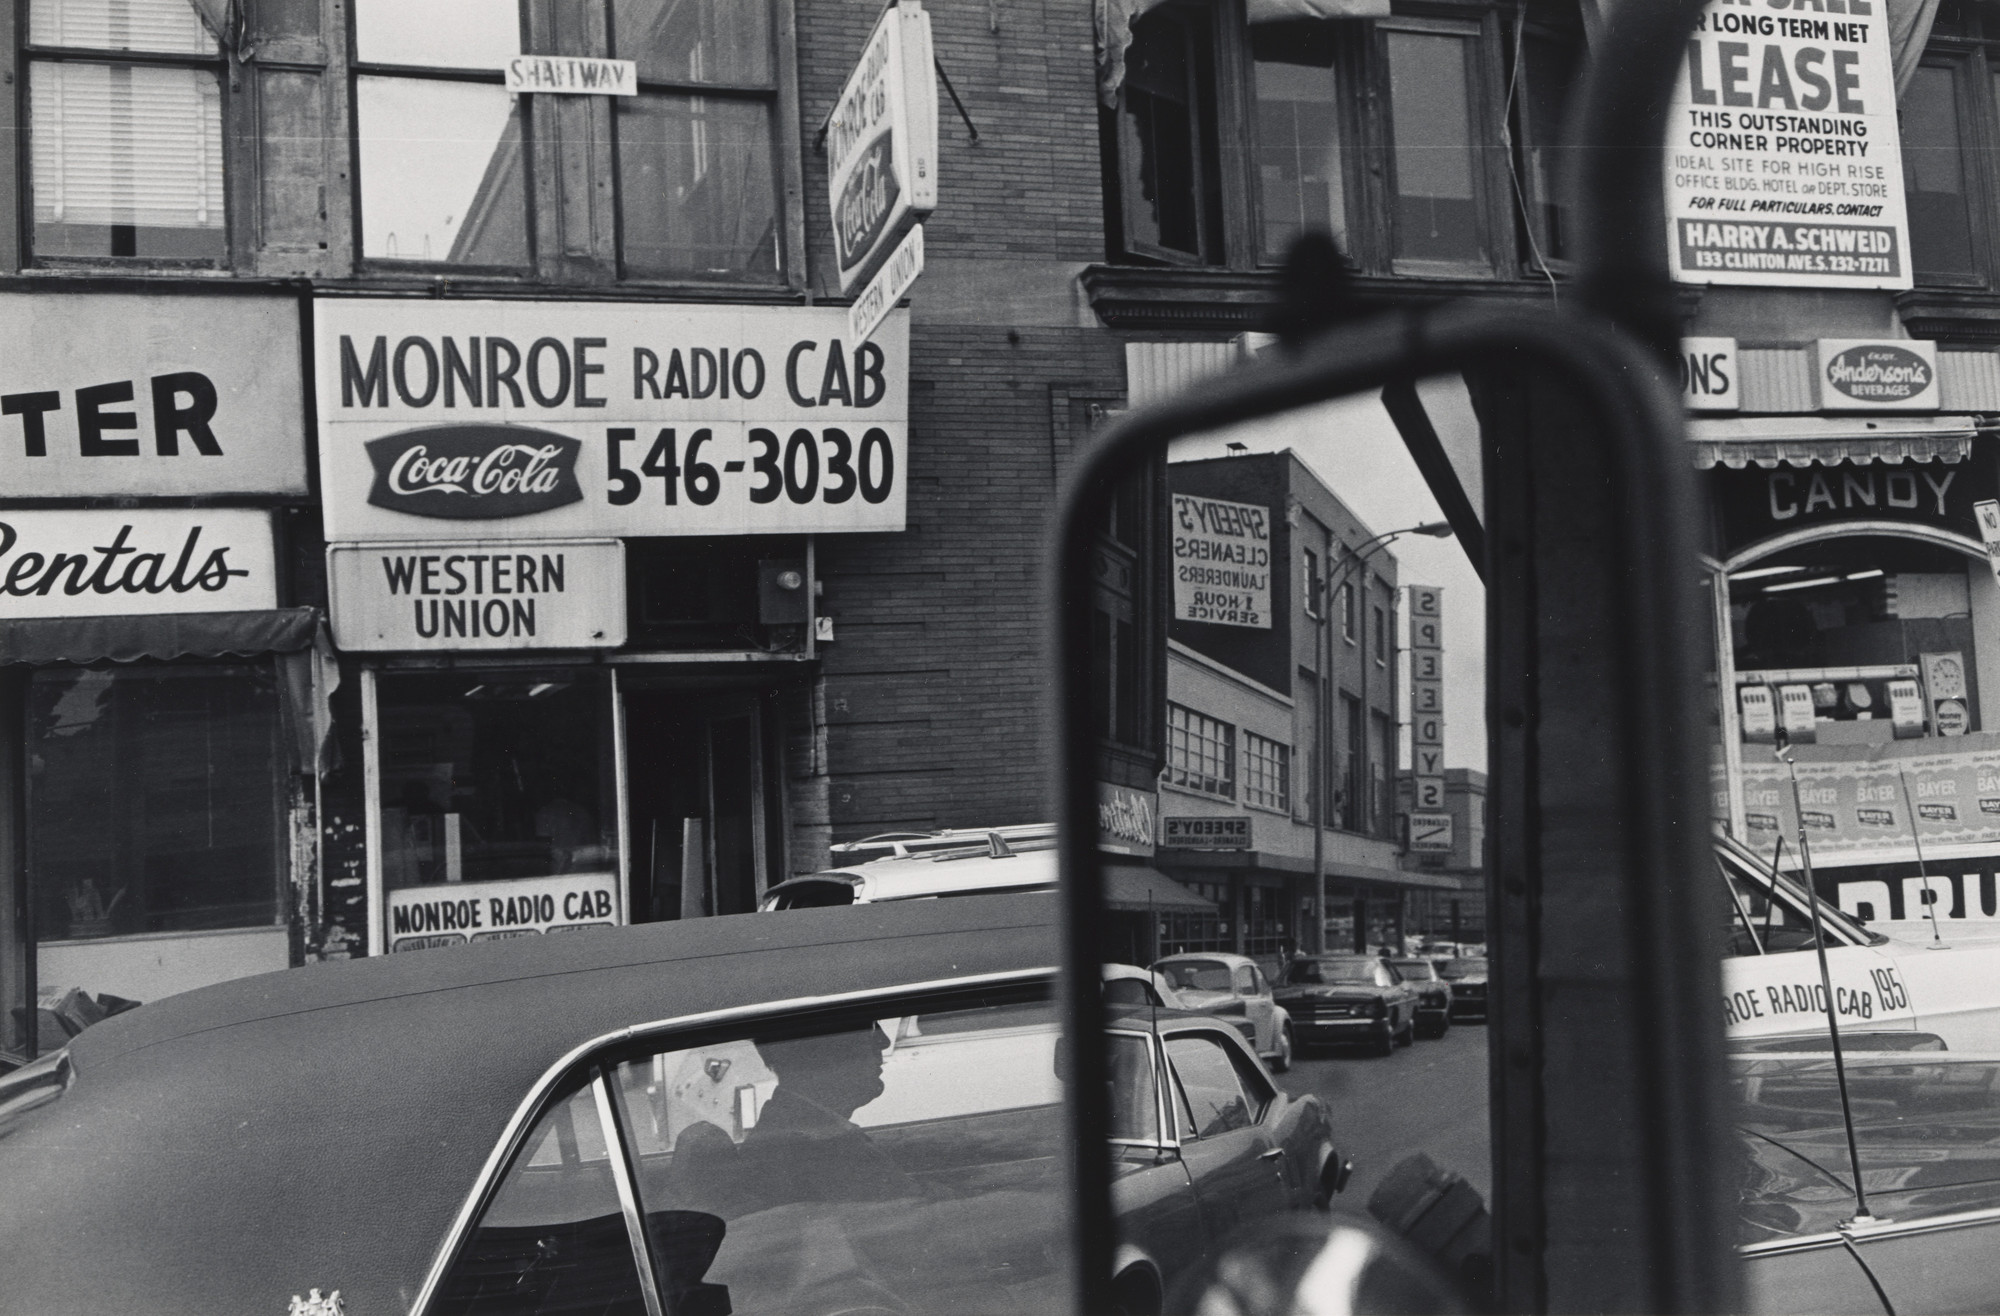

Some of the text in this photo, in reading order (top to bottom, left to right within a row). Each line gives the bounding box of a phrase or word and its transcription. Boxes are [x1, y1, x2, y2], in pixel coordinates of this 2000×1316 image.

[1713, 13, 1774, 36] LONG
[1778, 17, 1829, 40] TERM
[1834, 22, 1869, 43] NET
[1686, 39, 1864, 115] LEASE
[1689, 110, 1867, 137] THIS OUTSTANDING
[1690, 132, 1868, 157] CORNER PROPERTY
[1676, 155, 1884, 180] IDEAL SITE FOR HIGH RISE
[1675, 174, 1719, 190] OFFICE
[1725, 176, 1759, 191] BLDG.
[1763, 178, 1798, 194] HOTEL
[1818, 181, 1850, 197] DEPT.
[1851, 183, 1888, 198] STORE
[1689, 197, 1715, 210] FOR
[1718, 198, 1746, 212] FULL
[1837, 204, 1883, 217] CONTACT
[1686, 223, 1891, 253] HARRY A. SCHWEID
[1695, 251, 1722, 267] 133
[1725, 252, 1785, 269] CLINTON
[339, 335, 886, 408] MONROE RADIO CAB
[1830, 354, 1926, 384] Anderson's
[1851, 384, 1911, 396] BEVERAGES
[1, 371, 224, 457] TER
[388, 442, 564, 496] Coca-Cola
[606, 427, 895, 506] 546-3030
[1769, 470, 1956, 521] CANDY
[1983, 512, 1997, 529] NO
[381, 554, 565, 595] WESTERN
[414, 599, 536, 639] UNION
[1856, 785, 1895, 803] BAYER
[1917, 780, 1957, 798] BAYER
[393, 889, 613, 935] MONROE RADIO CAB
[1836, 986, 1873, 1019] CAB
[1870, 967, 1907, 1011] 195
